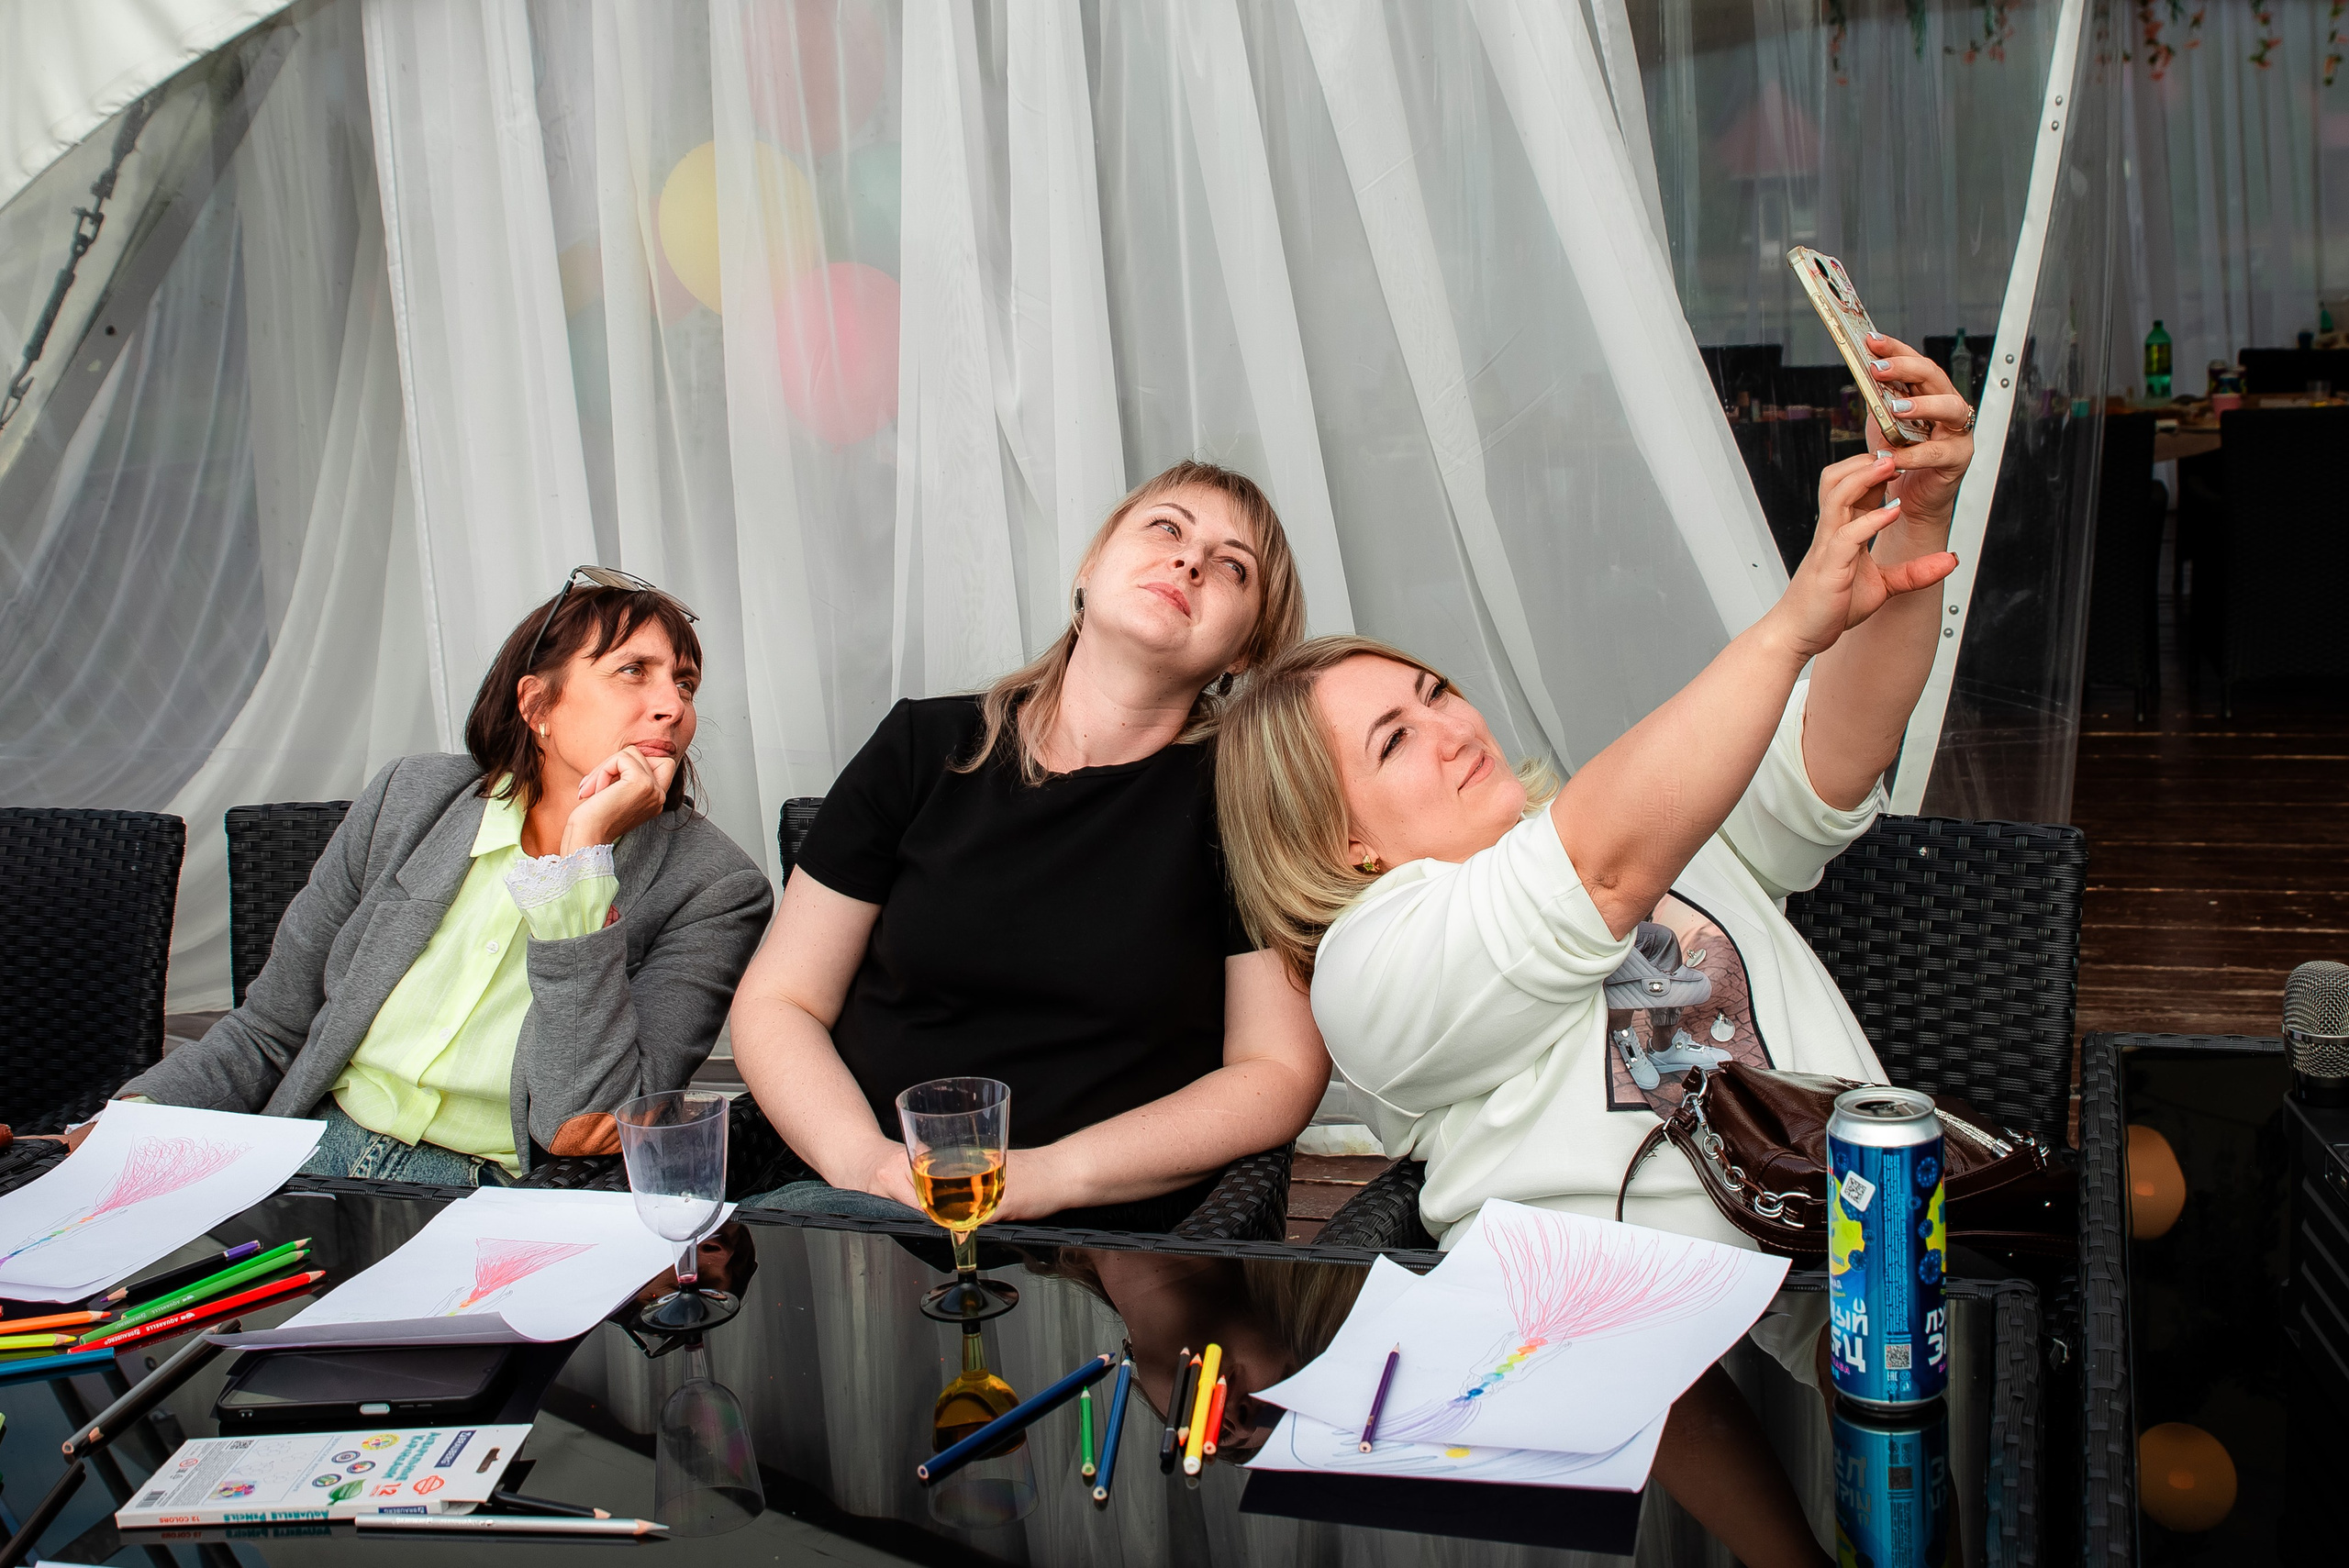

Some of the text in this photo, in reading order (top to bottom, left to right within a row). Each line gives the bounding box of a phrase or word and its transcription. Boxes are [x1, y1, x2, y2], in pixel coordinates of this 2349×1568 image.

[117, 1301, 181, 1329] BRAUBERG AQUARELLE
[108, 1330, 135, 1344] BRAUBERG
[146, 1317, 179, 1332] AQUARELLE
[440, 1435, 468, 1465] BRAUBERG
[378, 1483, 402, 1496] 12
